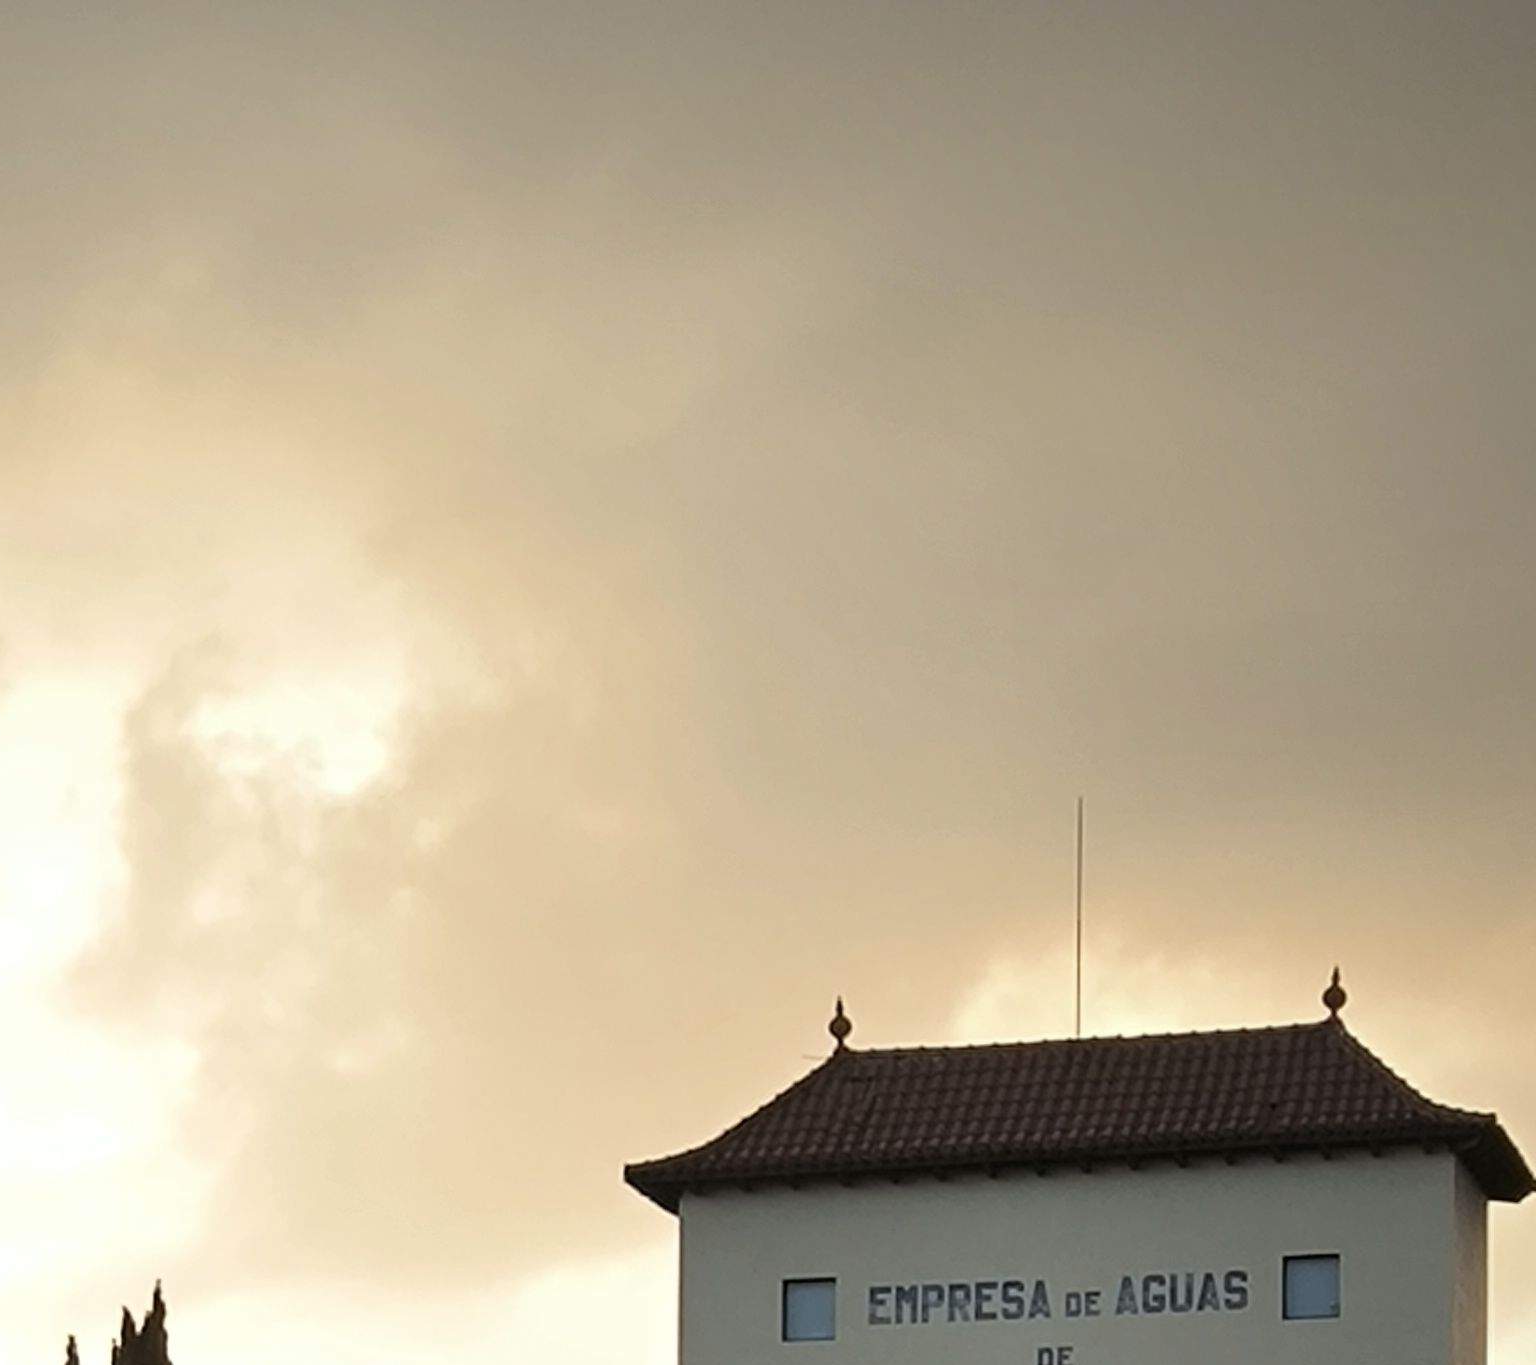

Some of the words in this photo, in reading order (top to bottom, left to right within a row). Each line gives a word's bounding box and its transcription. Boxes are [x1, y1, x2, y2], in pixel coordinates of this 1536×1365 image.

[868, 1280, 1051, 1325] EMPRESA
[1065, 1291, 1101, 1317] DE
[1115, 1270, 1248, 1315] AGUAS
